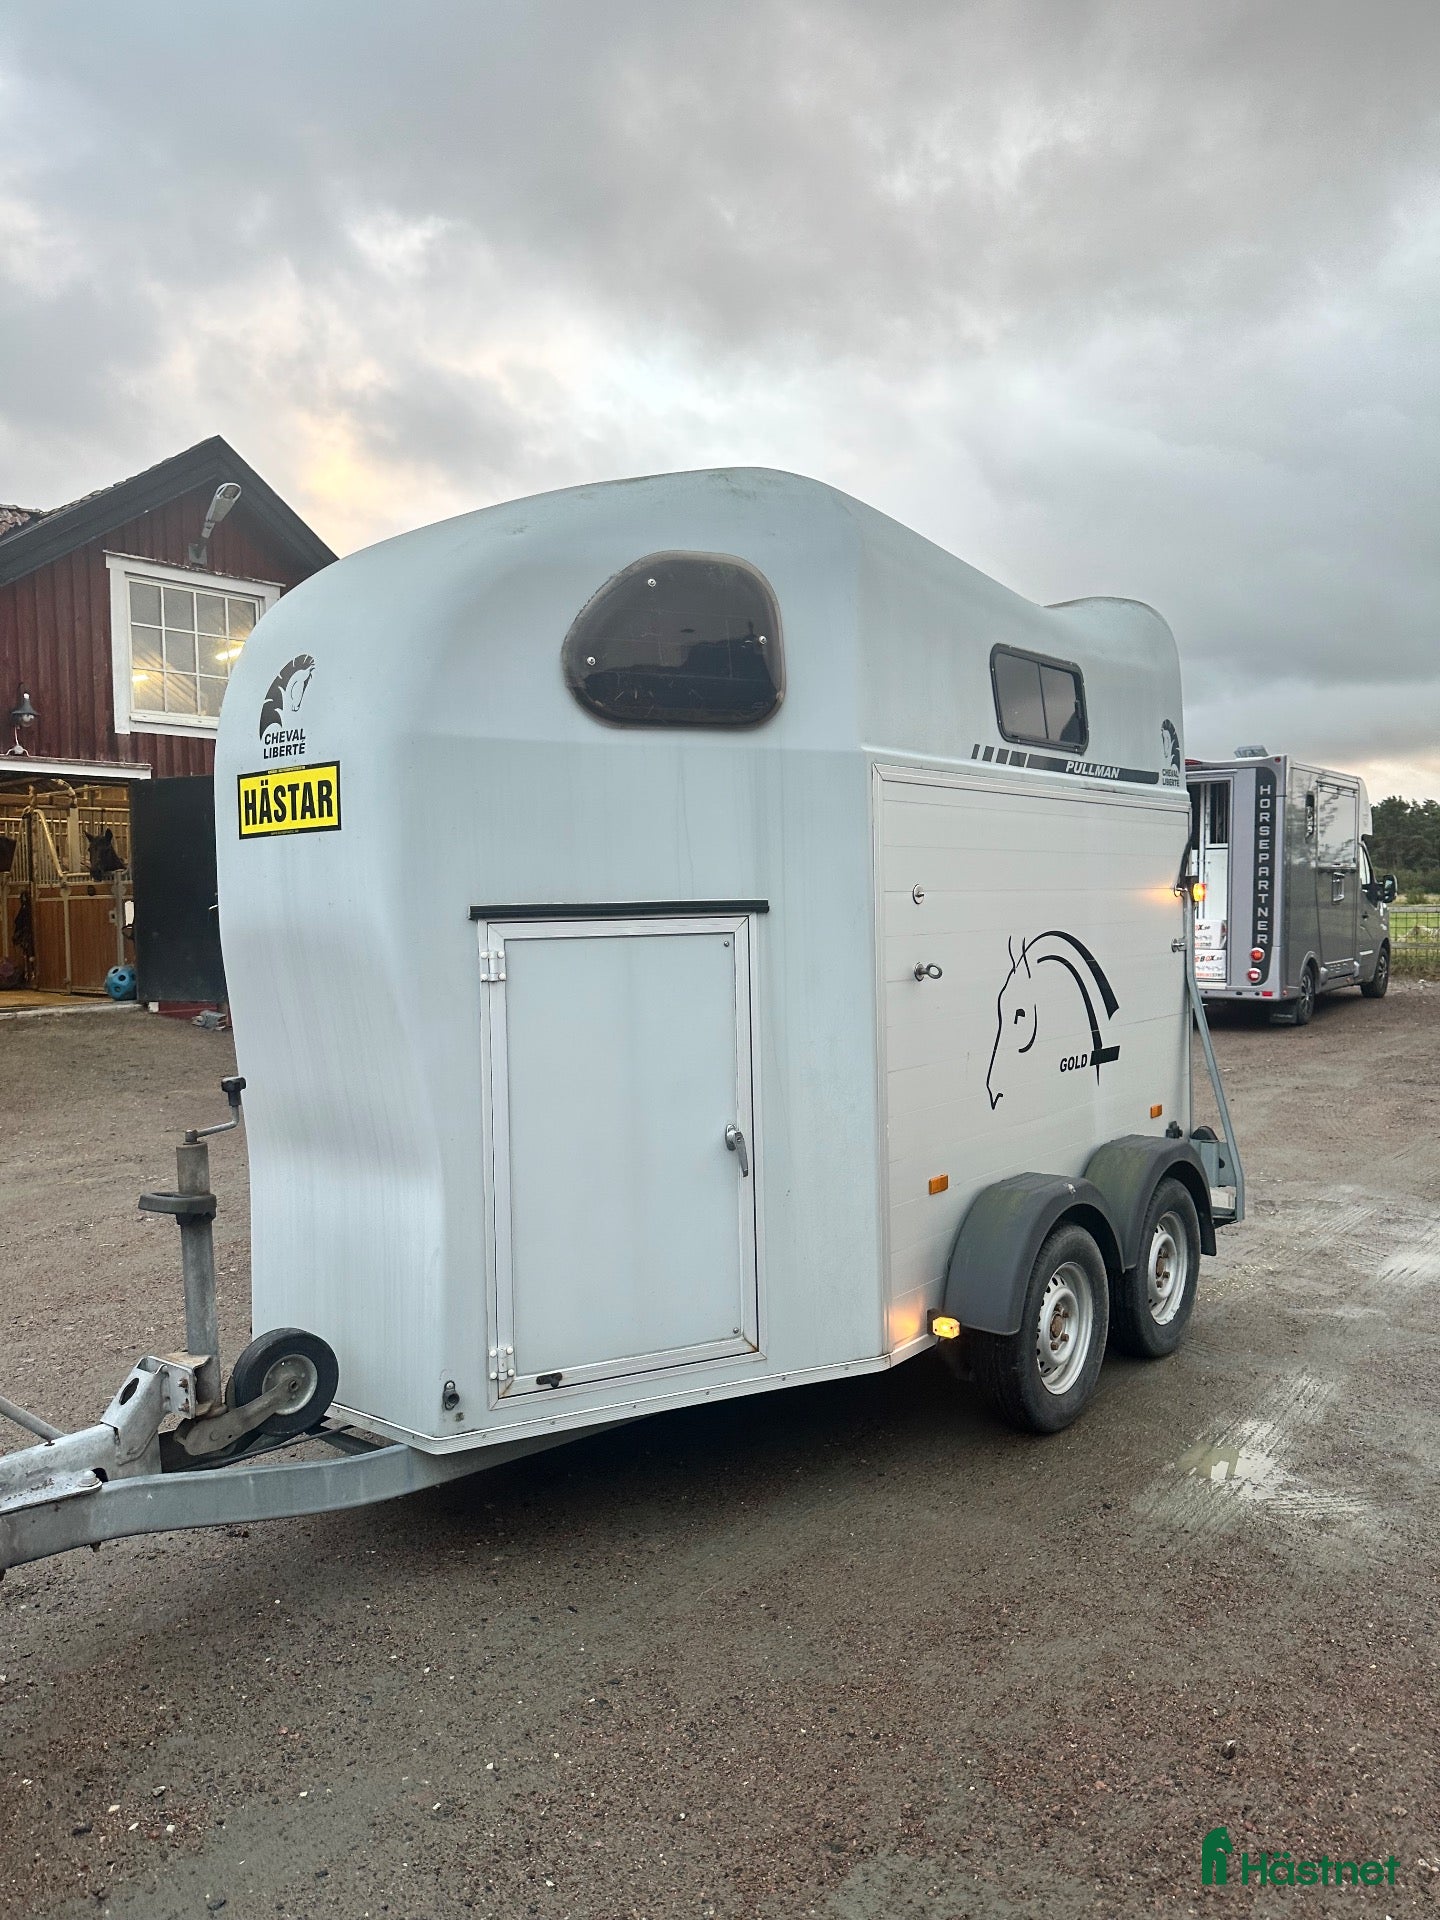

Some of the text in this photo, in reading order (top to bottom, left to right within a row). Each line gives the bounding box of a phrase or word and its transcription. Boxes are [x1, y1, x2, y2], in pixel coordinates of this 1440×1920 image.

[264, 728, 306, 746] CHEVAL
[263, 741, 306, 759] LIBERTÉ
[1065, 760, 1120, 779] PULLMAN
[243, 779, 333, 826] HÄSTAR
[1256, 784, 1271, 945] HORSEPARTNER
[1059, 1053, 1088, 1072] GOLD
